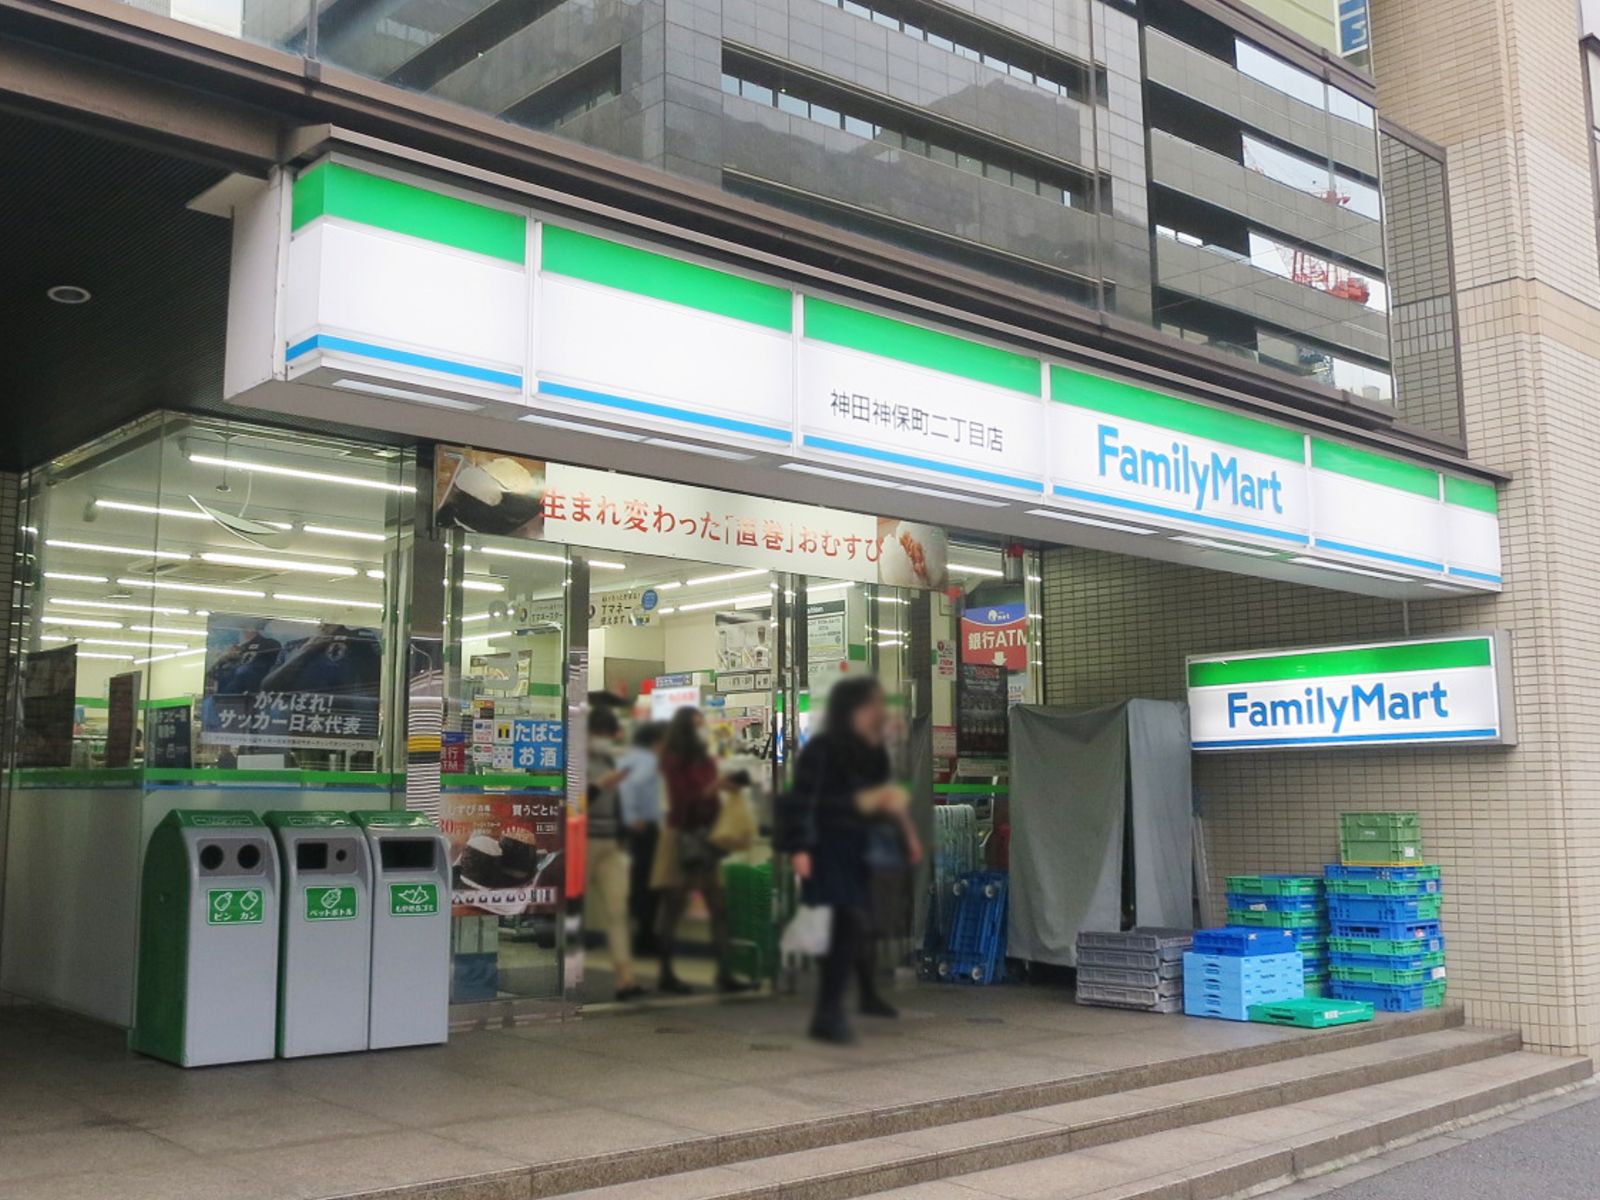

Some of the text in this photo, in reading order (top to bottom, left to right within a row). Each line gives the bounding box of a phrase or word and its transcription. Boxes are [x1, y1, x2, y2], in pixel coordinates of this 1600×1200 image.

[830, 388, 1003, 452] 神田神保町二丁目店
[1097, 424, 1283, 513] FamilyMart
[538, 486, 885, 563] 生まれ変わった「直巻」おむすび
[967, 629, 1027, 651] 銀行ATM
[253, 690, 334, 713] がんばれ!
[1227, 681, 1448, 733] FamilyMart
[218, 709, 362, 735] サッカー日本代表
[515, 723, 562, 742] たばこ
[519, 746, 557, 767] お酒
[512, 804, 559, 817] 買うごとに
[214, 911, 258, 921] ビン カン
[309, 908, 353, 917] ペットボトル
